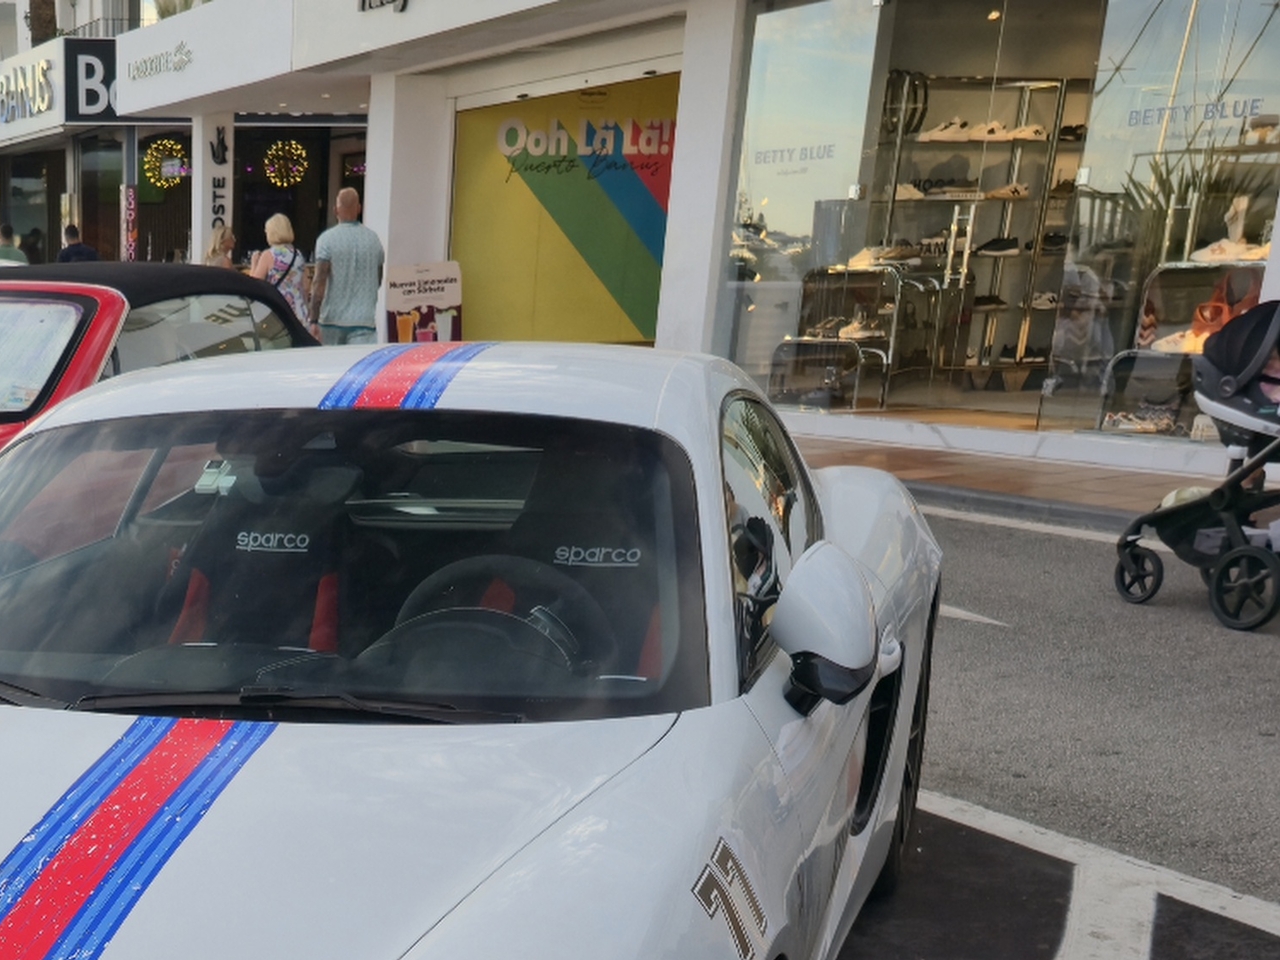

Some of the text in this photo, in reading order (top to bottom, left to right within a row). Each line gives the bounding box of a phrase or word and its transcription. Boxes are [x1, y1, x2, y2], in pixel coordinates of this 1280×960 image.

[1128, 99, 1263, 127] BETTY BLUE
[497, 116, 569, 157] Ooh
[505, 148, 580, 183] Puerto
[755, 144, 835, 165] BETTY BLUE
[236, 530, 310, 551] sparco
[554, 545, 641, 566] sparco
